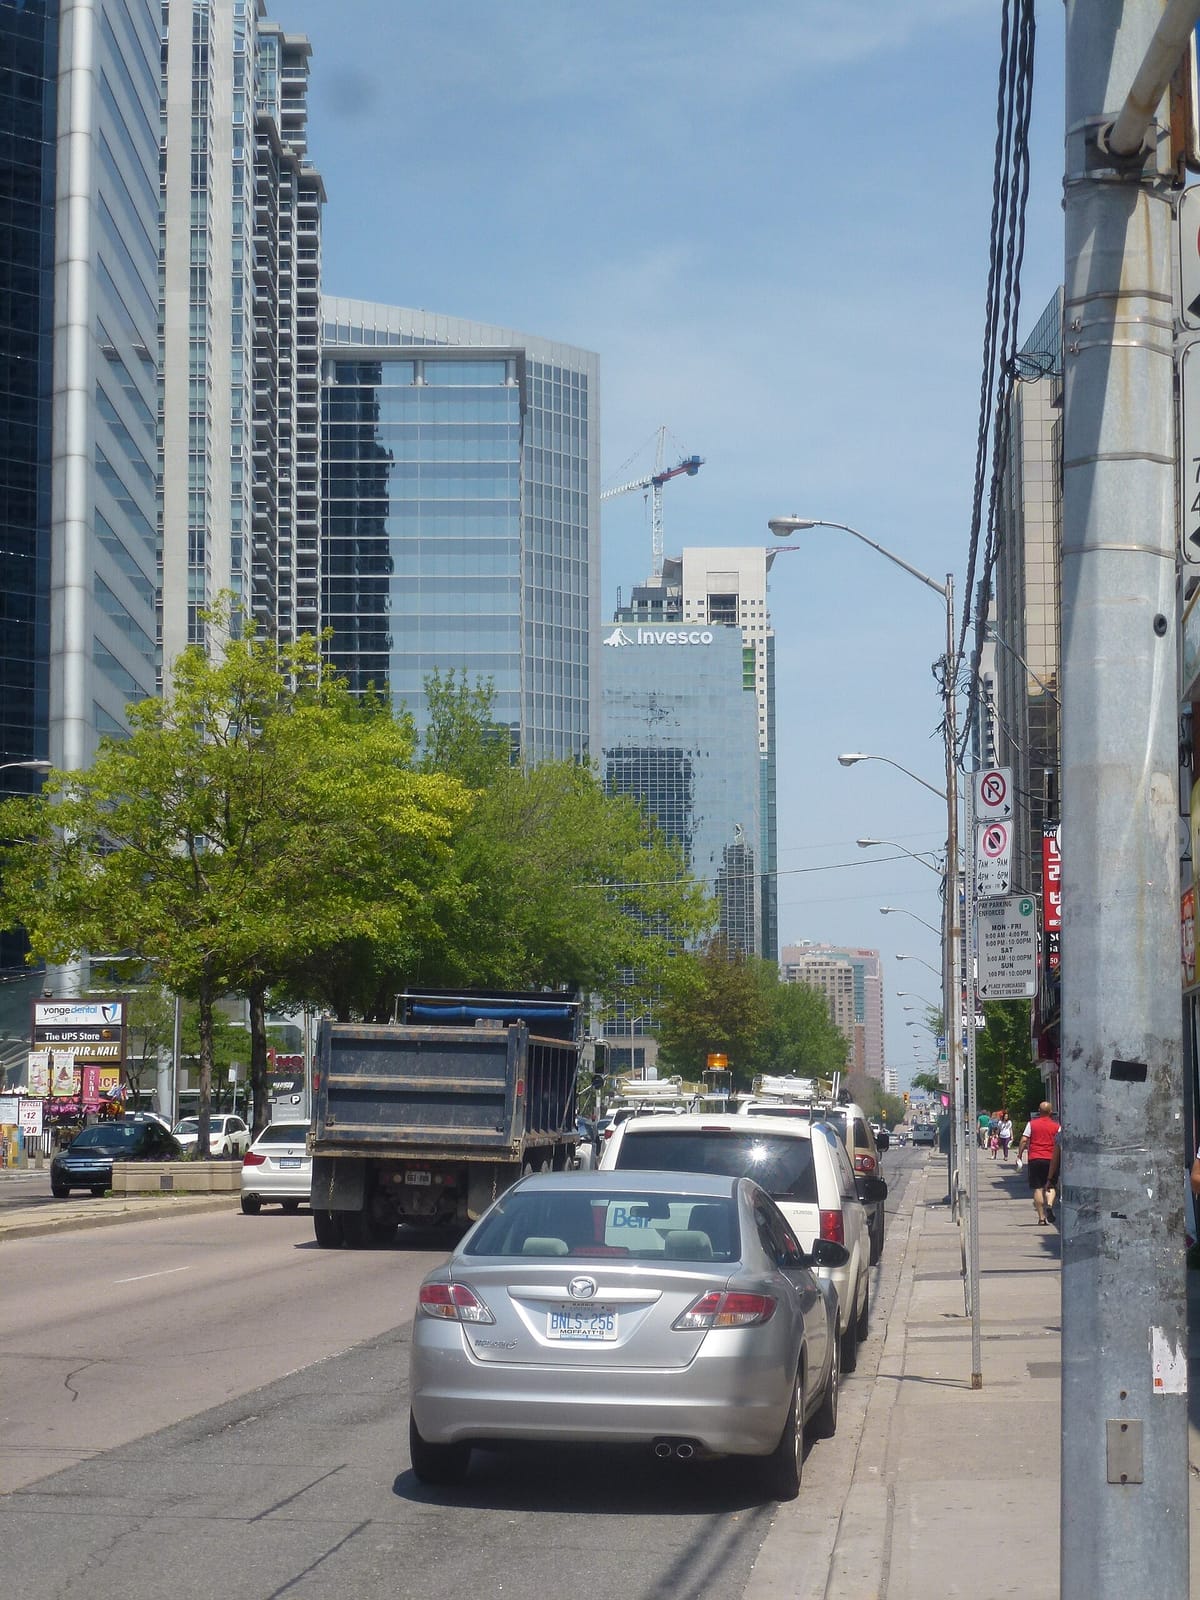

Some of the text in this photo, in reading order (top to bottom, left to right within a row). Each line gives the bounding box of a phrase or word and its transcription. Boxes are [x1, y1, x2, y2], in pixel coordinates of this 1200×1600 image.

[637, 628, 713, 645] Invesco
[978, 859, 989, 869] 7AM
[997, 857, 1008, 867] 9AM
[978, 871, 989, 880] 4PM
[997, 870, 1008, 880] 6PM
[989, 900, 1012, 908] PARKING
[979, 909, 1005, 917] ENFORCED
[45, 1032, 100, 1040] The UPS Store
[67, 1046, 91, 1056] HAIR
[97, 1046, 118, 1056] NAIL
